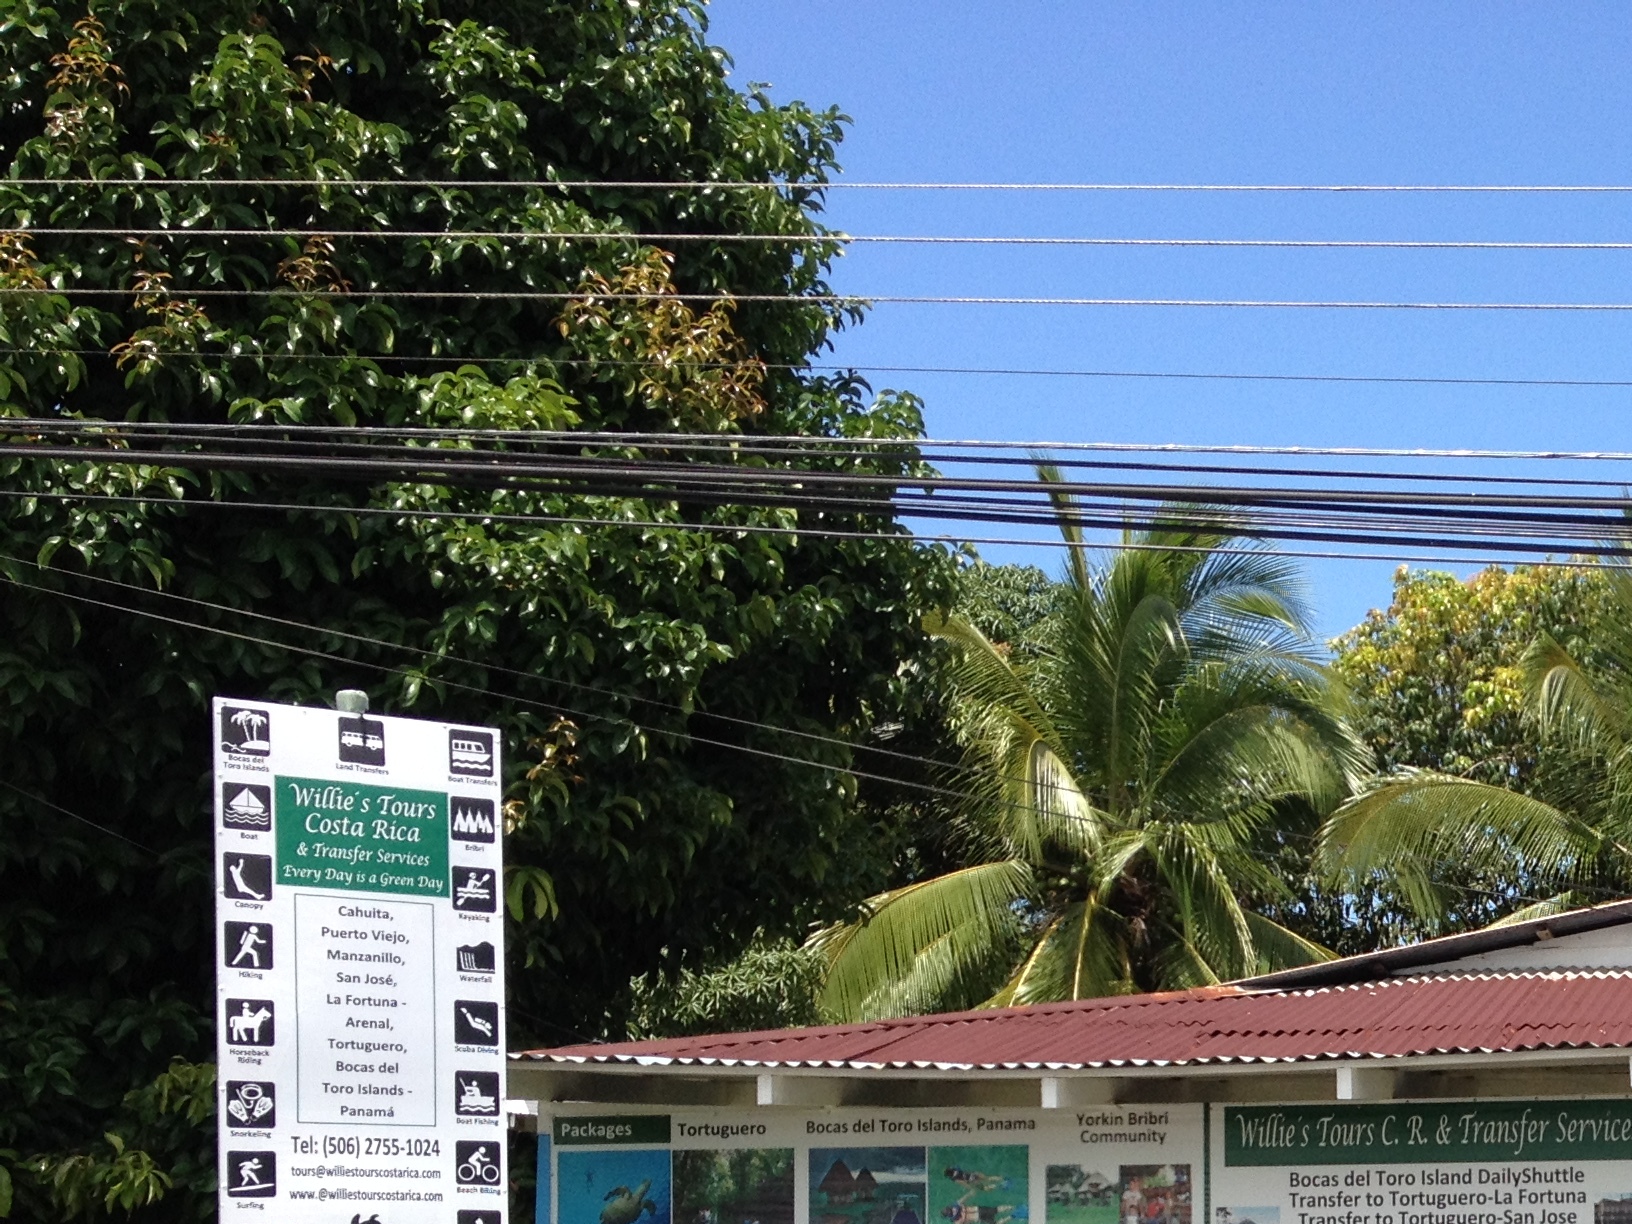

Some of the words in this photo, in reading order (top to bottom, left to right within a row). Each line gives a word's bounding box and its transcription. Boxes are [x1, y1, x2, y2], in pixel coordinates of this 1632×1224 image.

[377, 795, 436, 819] Tours
[305, 813, 364, 837] Costa
[371, 819, 420, 842] Rica
[297, 842, 307, 855] &
[312, 843, 372, 865] Transfer
[377, 850, 429, 866] Services
[283, 864, 321, 882] Every
[325, 868, 353, 886] Day
[356, 871, 364, 882] is
[368, 874, 376, 883] a
[380, 873, 413, 889] Green
[417, 875, 443, 889] Day
[235, 901, 263, 910] Canopy
[338, 906, 393, 921] Cahuita,
[459, 913, 490, 923] Kayaking
[321, 927, 367, 941] Puerto
[372, 929, 409, 944] Viejo,
[327, 949, 405, 966] Manzanillo,
[239, 971, 263, 980] Hiking
[336, 972, 360, 984] San
[364, 973, 397, 987] José,
[459, 975, 492, 983] Waterfall
[326, 994, 341, 1006] La
[346, 995, 397, 1007] Fortuna
[345, 1017, 393, 1032] Arenal,
[328, 1038, 407, 1054] Tortuguero,
[336, 1061, 374, 1073] Bocas
[379, 1062, 399, 1073] del
[322, 1082, 353, 1094] Toro
[358, 1083, 403, 1096] Islands
[340, 1105, 394, 1118] Panamá
[806, 1120, 848, 1134] Bocas
[853, 1119, 875, 1133] del
[880, 1119, 913, 1133] Toro
[918, 1119, 972, 1133] Islands,
[977, 1118, 1036, 1131] Panama
[1077, 1113, 1123, 1127] Yorkin
[230, 1130, 271, 1139] Snorkeling
[561, 1123, 632, 1139] Packages
[678, 1123, 766, 1138] Tortuguero
[1080, 1129, 1166, 1145] Community
[1315, 1112, 1375, 1148] Tours
[1382, 1114, 1399, 1144] C.
[1407, 1114, 1428, 1144] R.
[1435, 1114, 1450, 1143] &
[1459, 1108, 1550, 1155] Transfer
[291, 1136, 318, 1154] Tel:
[323, 1135, 360, 1159] (506)
[365, 1137, 440, 1157] 2755-1024
[292, 1164, 441, 1179] tours@williestourscostarica.com
[1290, 1172, 1338, 1188] Bocas
[1344, 1171, 1371, 1187] del
[1376, 1171, 1416, 1186] Toro
[1421, 1169, 1472, 1186] Island
[1477, 1167, 1585, 1188] DailyShuttle
[1289, 1192, 1360, 1208] Transfer
[1366, 1194, 1383, 1207] to
[1389, 1190, 1512, 1210] Tortuguero-La
[1518, 1189, 1586, 1204] Fortuna
[1539, 1209, 1576, 1224] Jose
